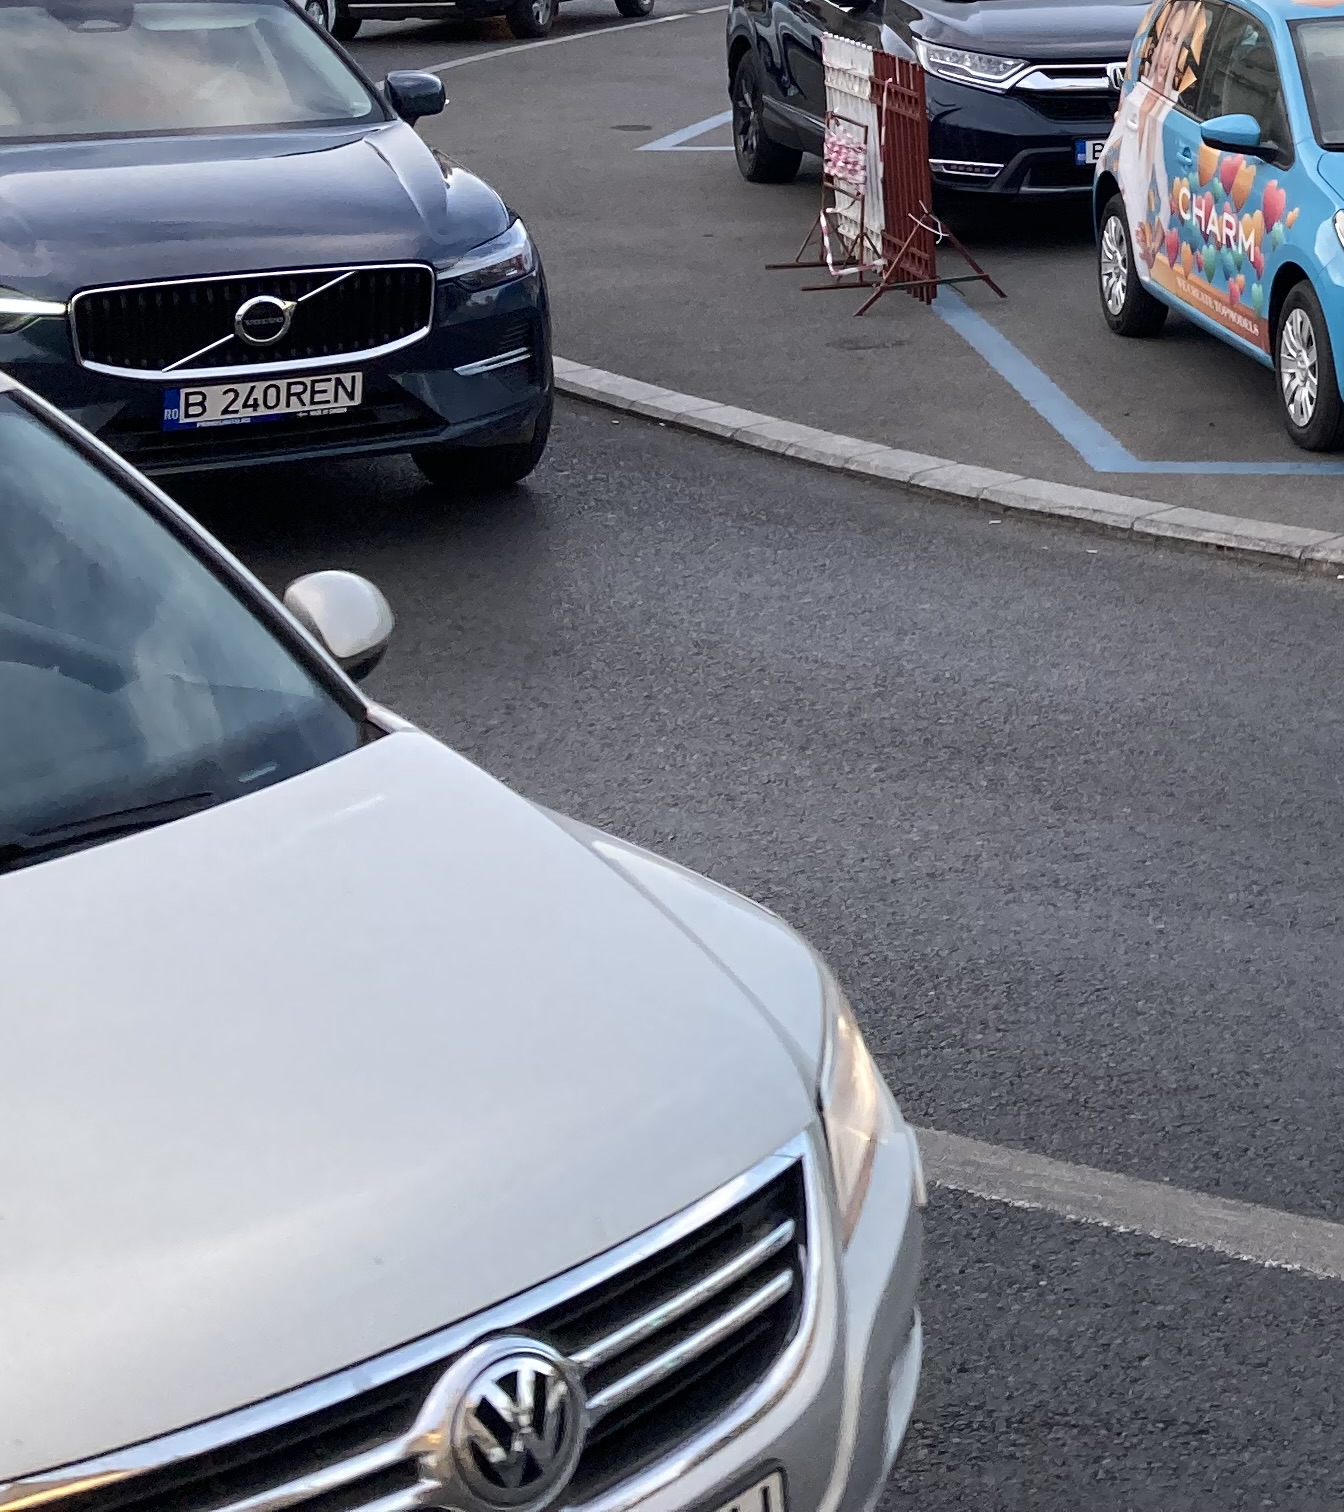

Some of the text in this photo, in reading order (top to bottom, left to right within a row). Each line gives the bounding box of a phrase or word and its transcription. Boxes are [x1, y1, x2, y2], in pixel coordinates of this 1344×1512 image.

[1179, 187, 1256, 262] CHARM
[164, 407, 179, 420] RO
[183, 391, 207, 419] B
